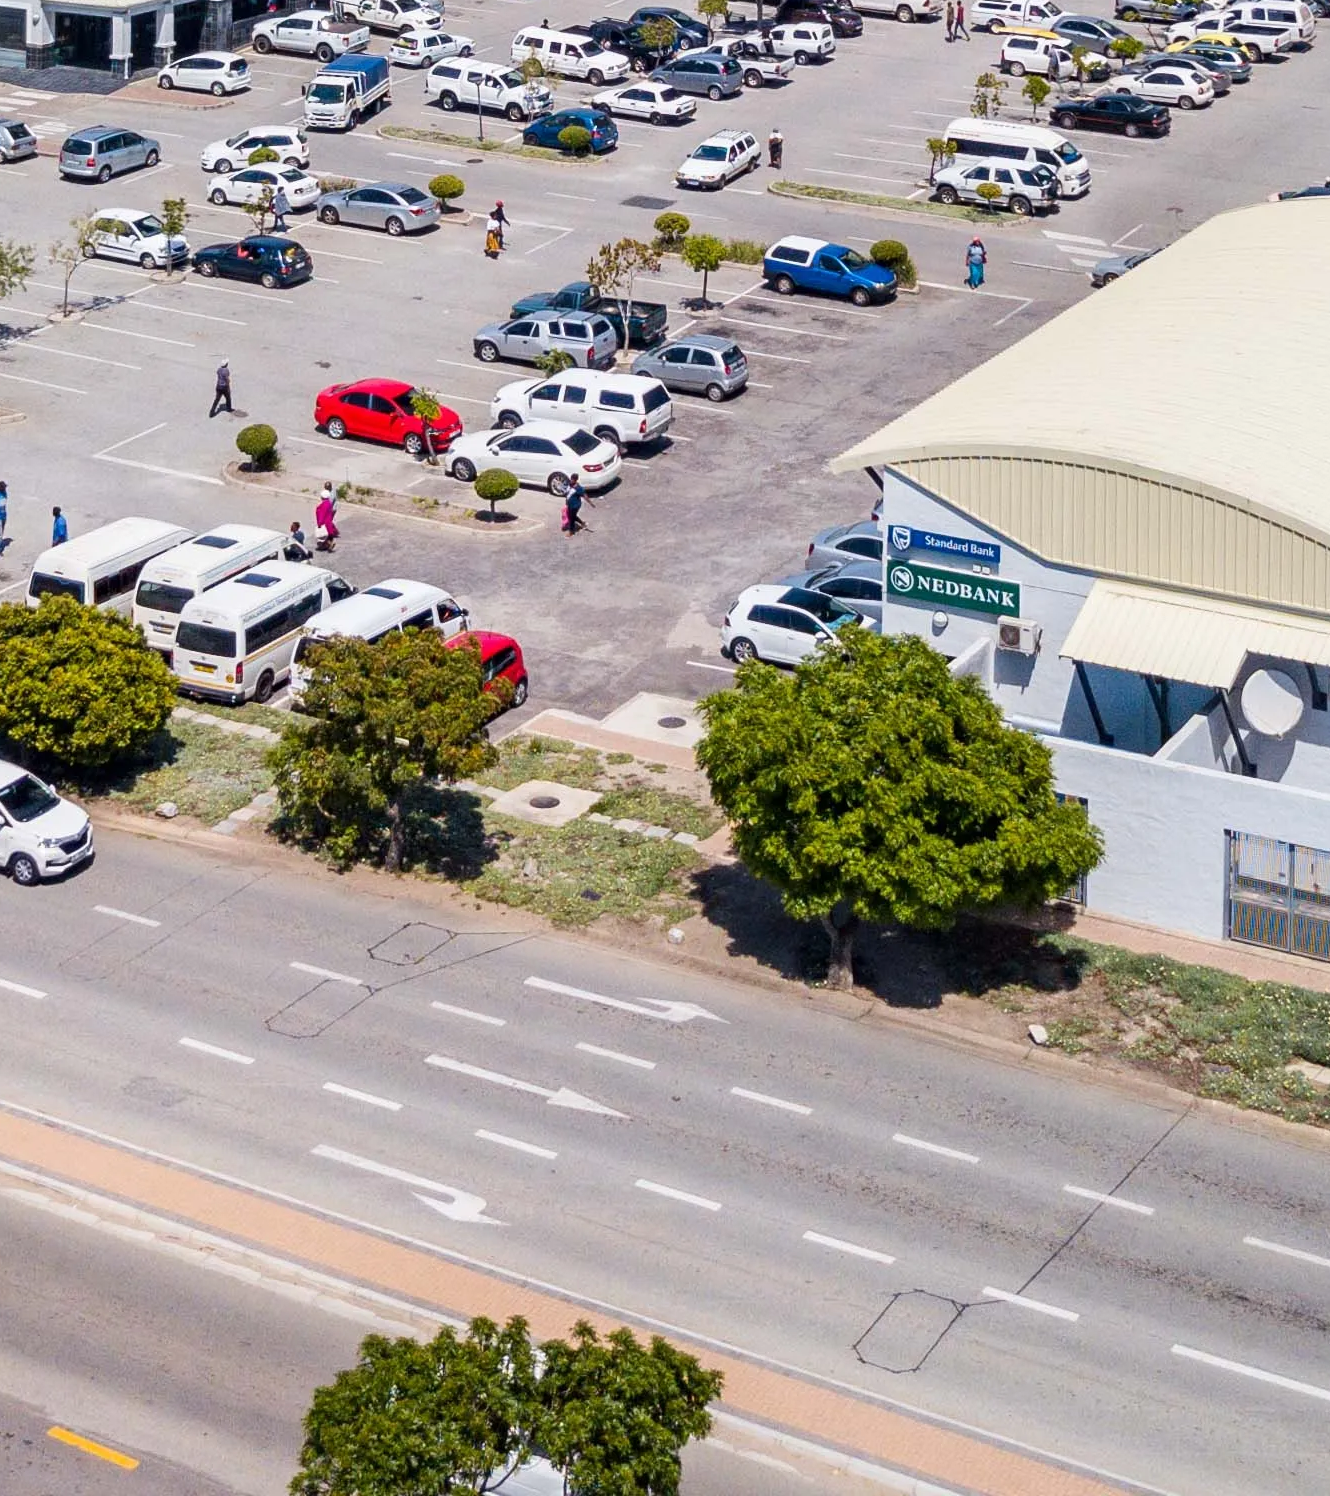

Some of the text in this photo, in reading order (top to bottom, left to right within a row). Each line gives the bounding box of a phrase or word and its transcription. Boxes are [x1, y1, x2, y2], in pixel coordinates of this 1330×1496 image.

[924, 535, 995, 558] Standard Bank
[917, 575, 1015, 608] NEDBANK
